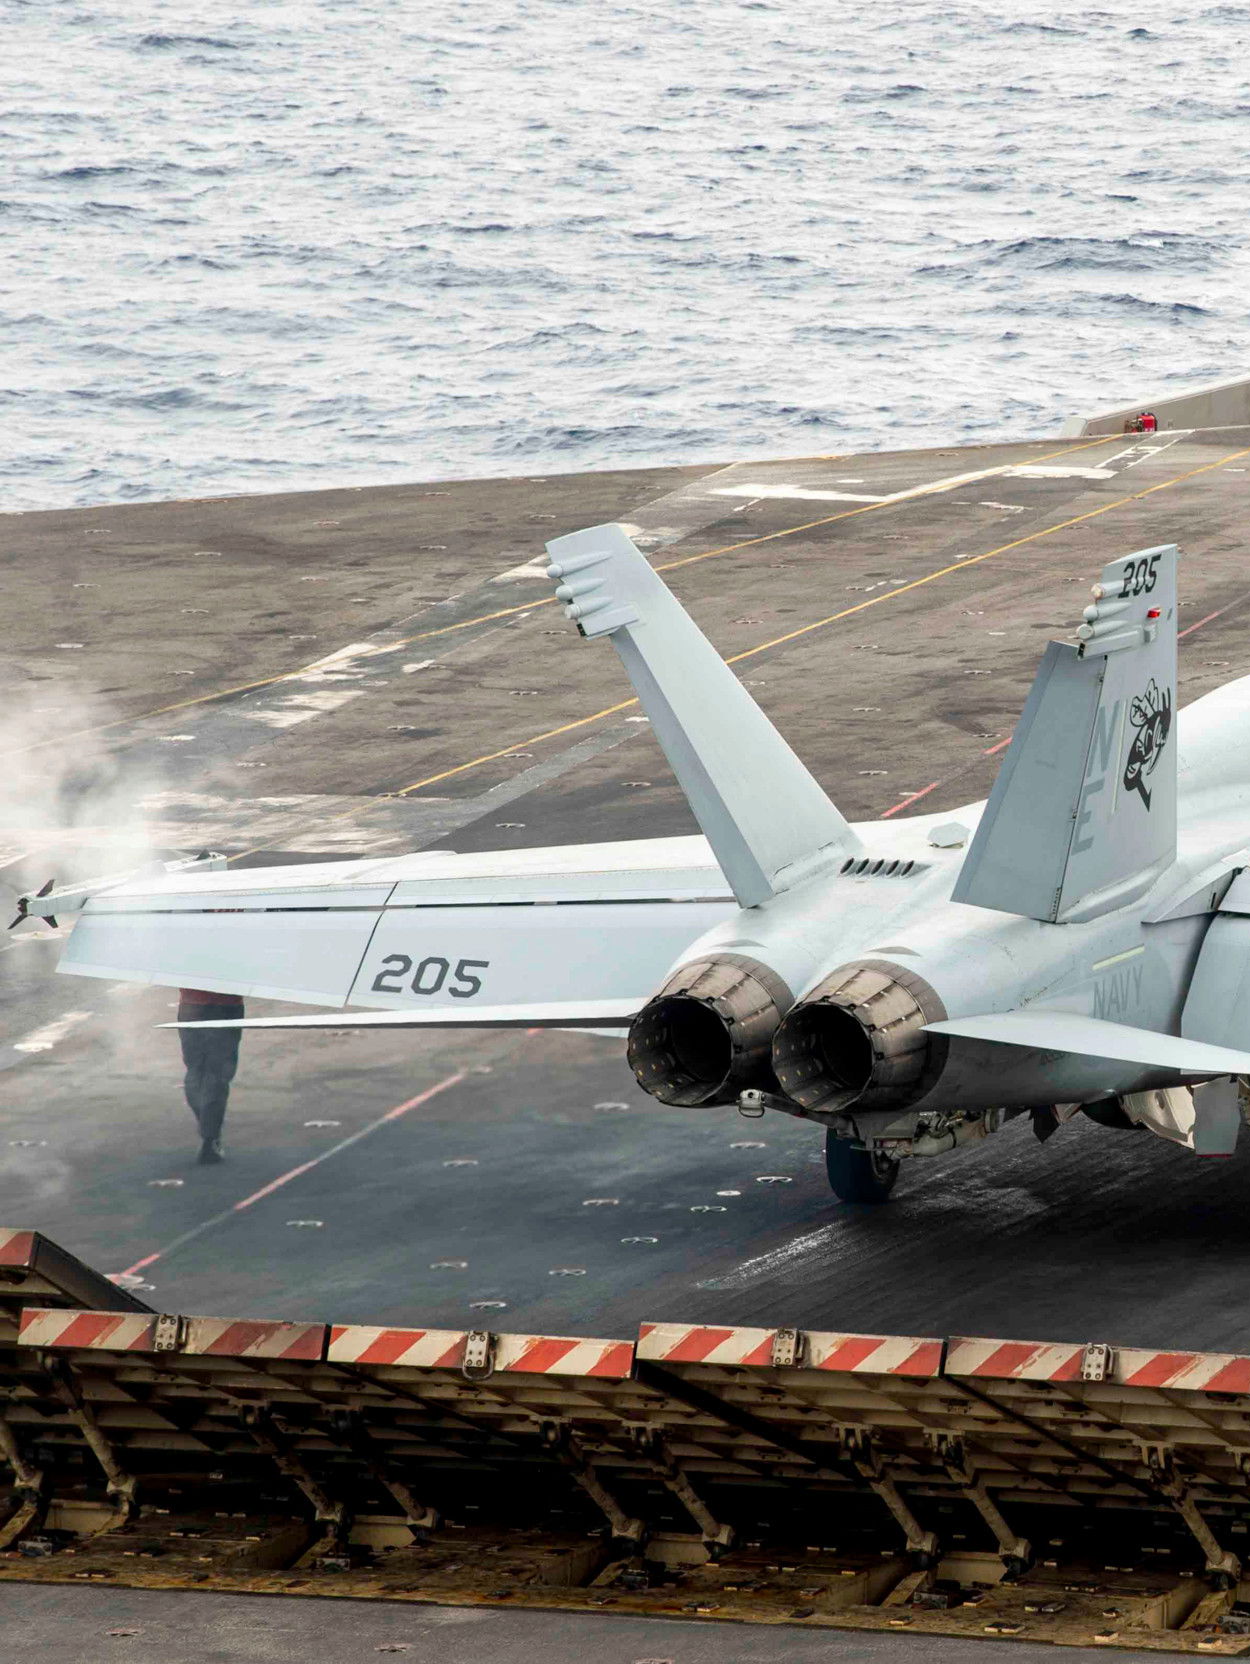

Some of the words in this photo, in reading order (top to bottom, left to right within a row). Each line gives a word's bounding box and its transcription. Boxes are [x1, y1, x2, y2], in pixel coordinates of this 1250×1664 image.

[1118, 554, 1161, 598] 205
[371, 954, 489, 998] 205
[1093, 964, 1143, 1020] NAVY
